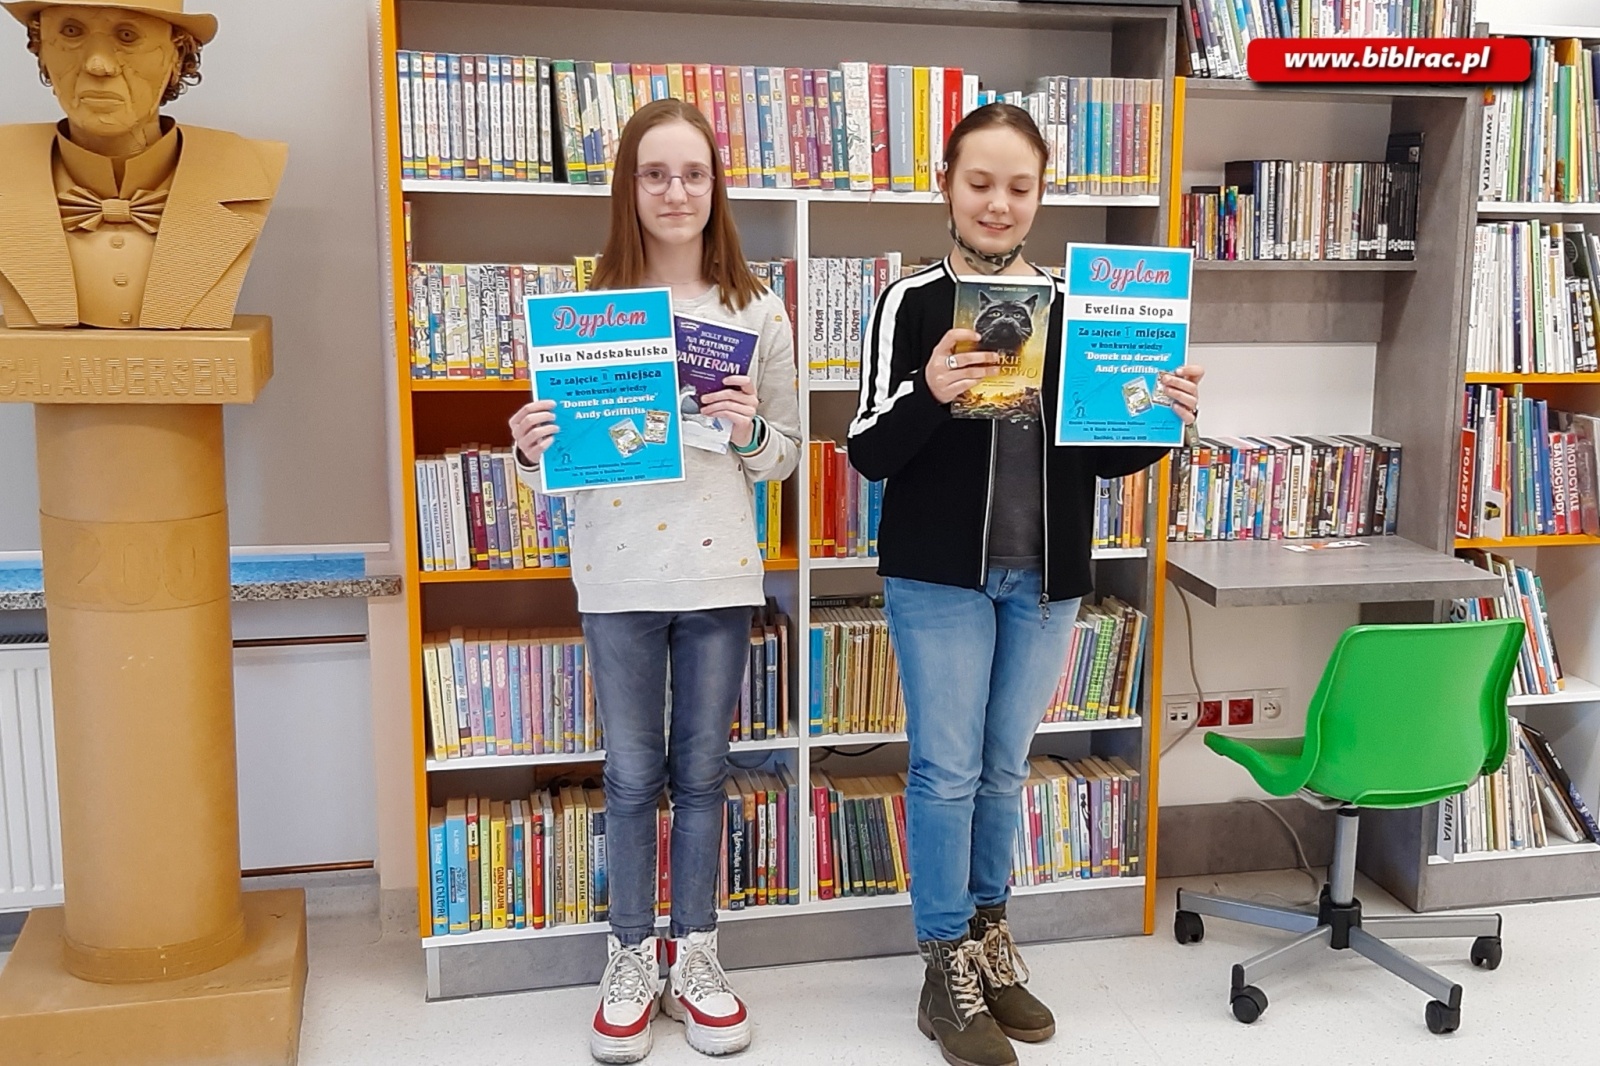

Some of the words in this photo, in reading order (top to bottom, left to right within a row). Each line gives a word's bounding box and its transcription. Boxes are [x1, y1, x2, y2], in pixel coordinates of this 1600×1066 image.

[1482, 113, 1494, 192] ZWIERZĘTA
[1091, 257, 1172, 291] Dyplom
[1084, 302, 1135, 316] Ewelina
[1138, 304, 1174, 318] Stopa
[553, 303, 648, 338] Dyplom
[1078, 328, 1089, 336] Za
[1092, 328, 1122, 338] zajęcie
[1136, 328, 1176, 340] miejsca
[698, 338, 736, 352] RATUNEK
[1099, 342, 1137, 350] konkursie
[1138, 342, 1162, 350] wiedzy
[538, 350, 572, 364] Julia
[576, 344, 669, 361] Nadskakulska
[57, 356, 239, 396] ANDERSEN
[1095, 364, 1119, 374] Andy
[550, 377, 561, 386] Za
[564, 375, 598, 386] zajęcie
[614, 370, 662, 382] miejsca
[574, 386, 618, 396] konkursie
[620, 384, 647, 394] wiedzy
[602, 396, 614, 406] na
[574, 409, 602, 420] Andy
[1460, 446, 1472, 513] POJAZDY
[1553, 443, 1565, 517] SAMOCHODY
[1566, 443, 1580, 512] MOTOCYKLE
